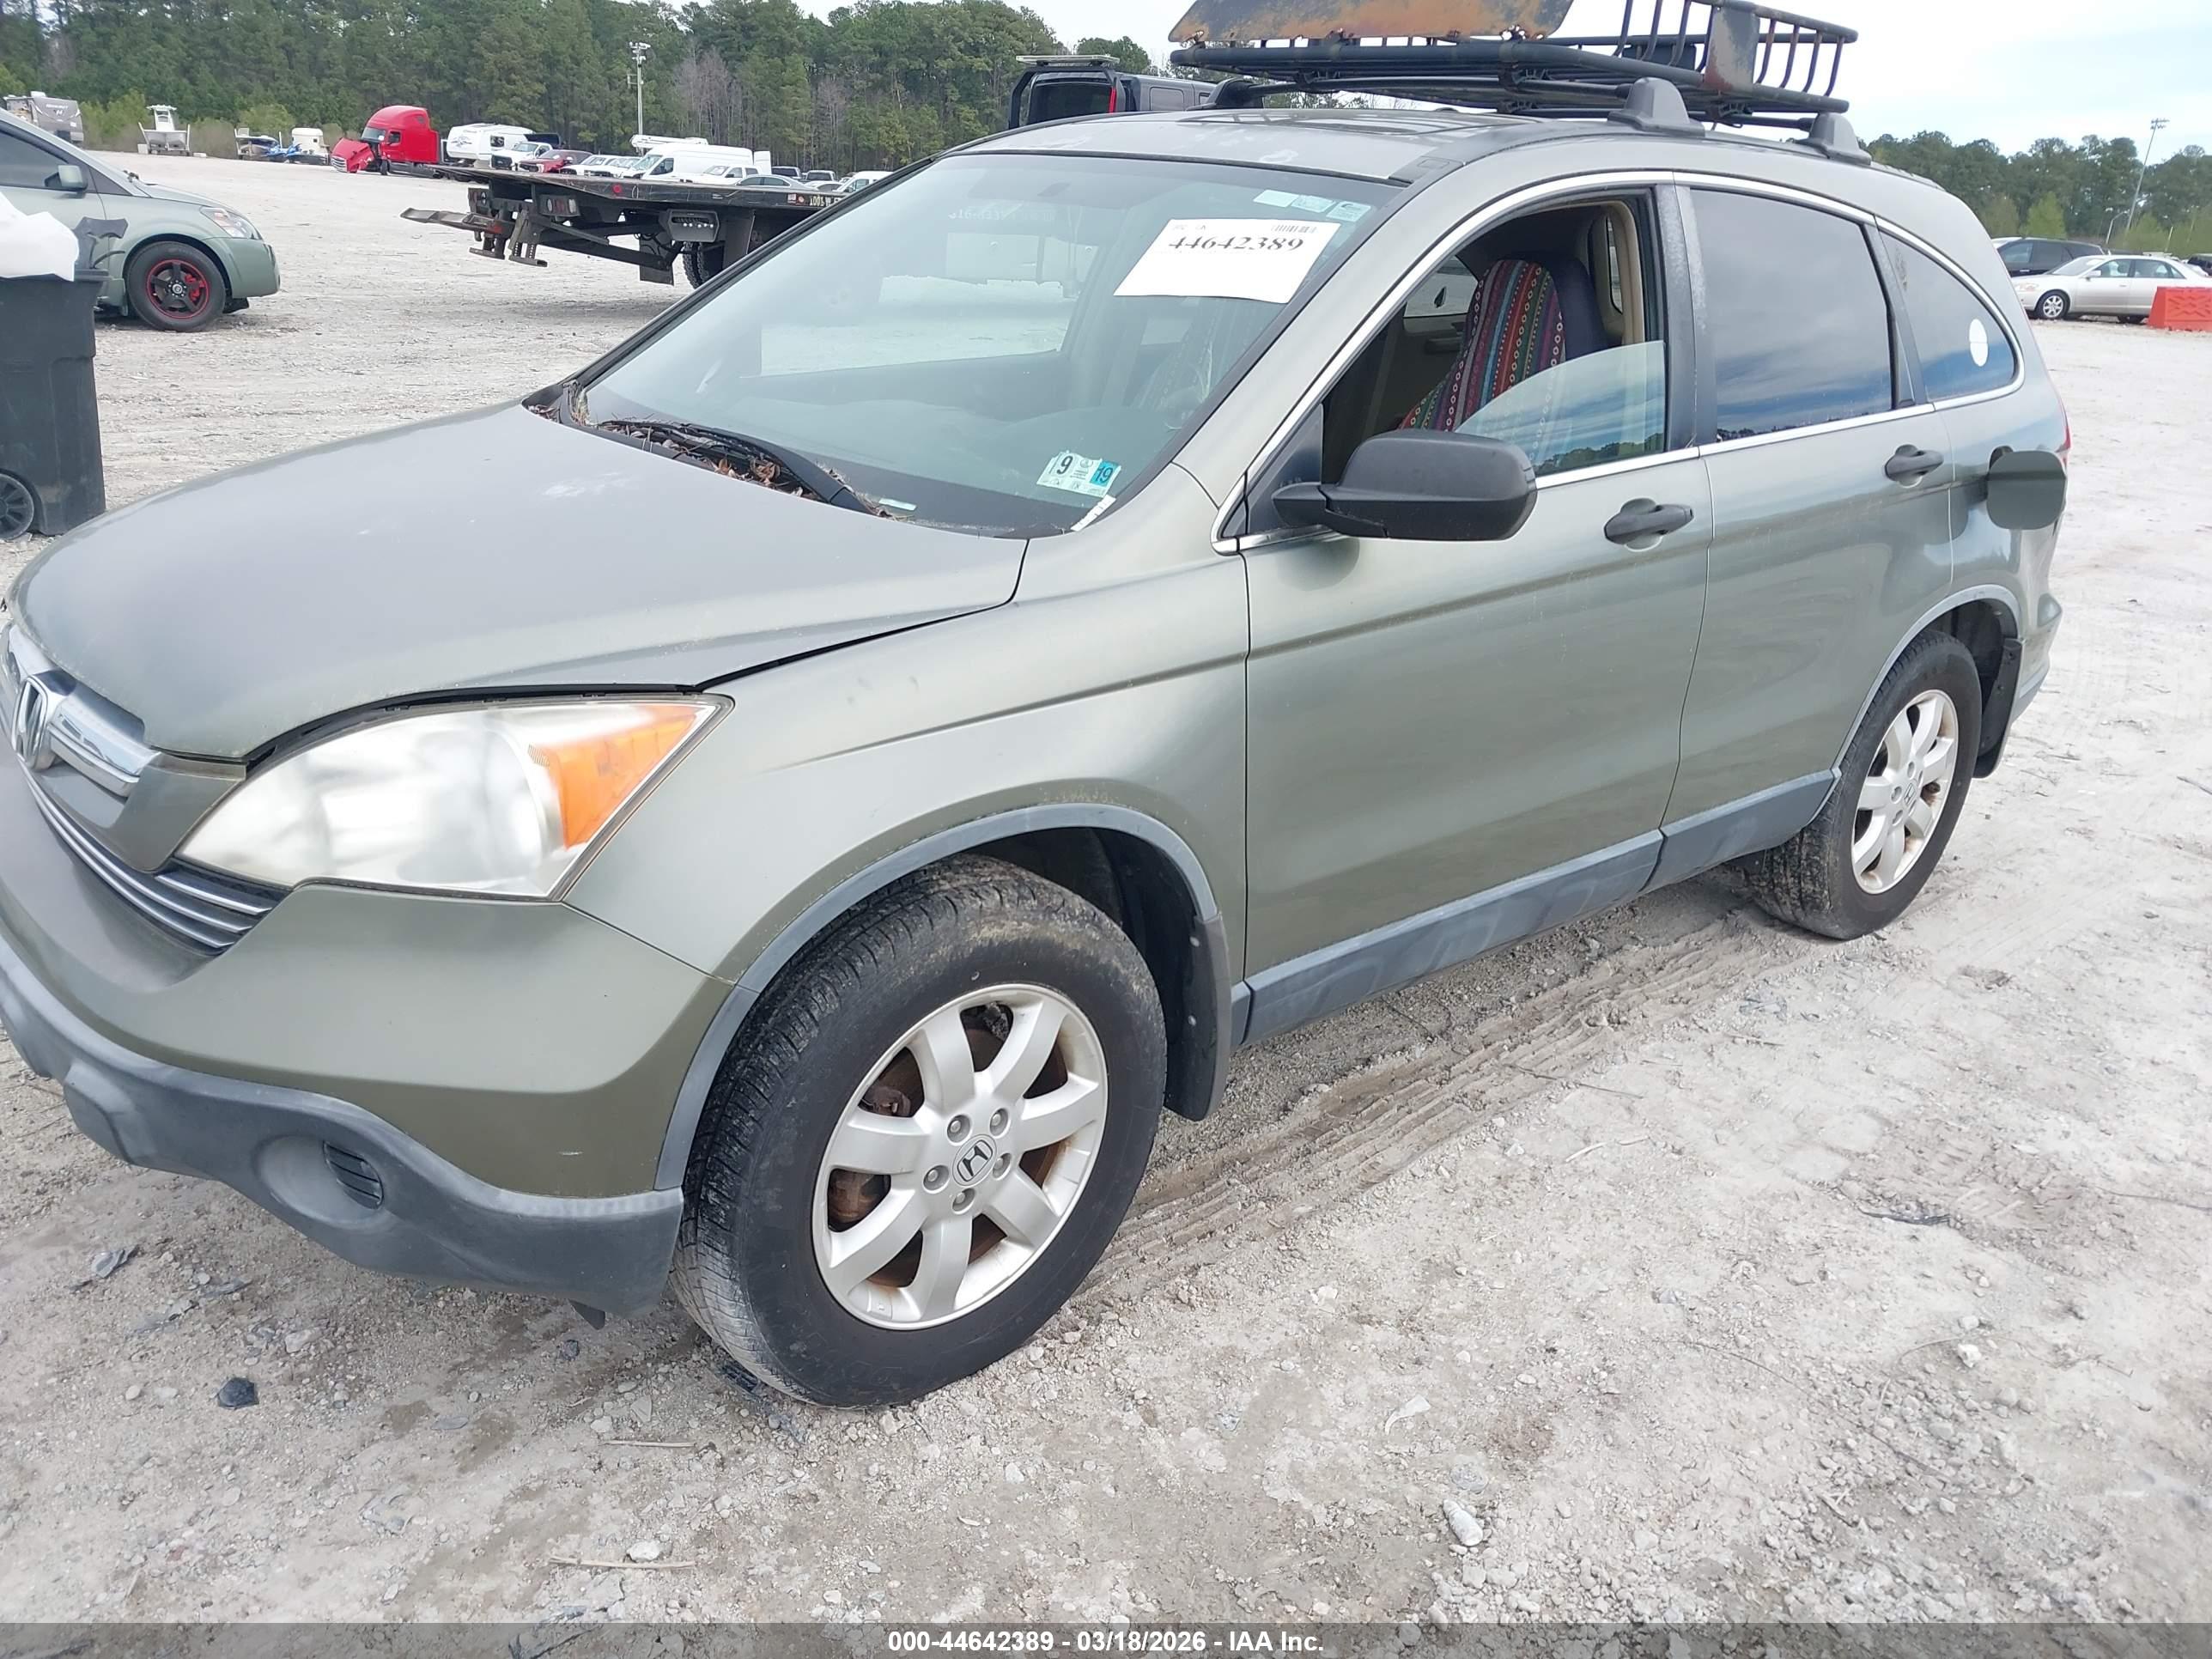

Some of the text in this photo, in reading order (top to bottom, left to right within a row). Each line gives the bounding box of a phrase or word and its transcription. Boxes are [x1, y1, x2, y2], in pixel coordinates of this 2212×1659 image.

[1168, 235, 1304, 251] 44642389
[1056, 455, 1073, 475] 9
[1095, 465, 1114, 484] 19
